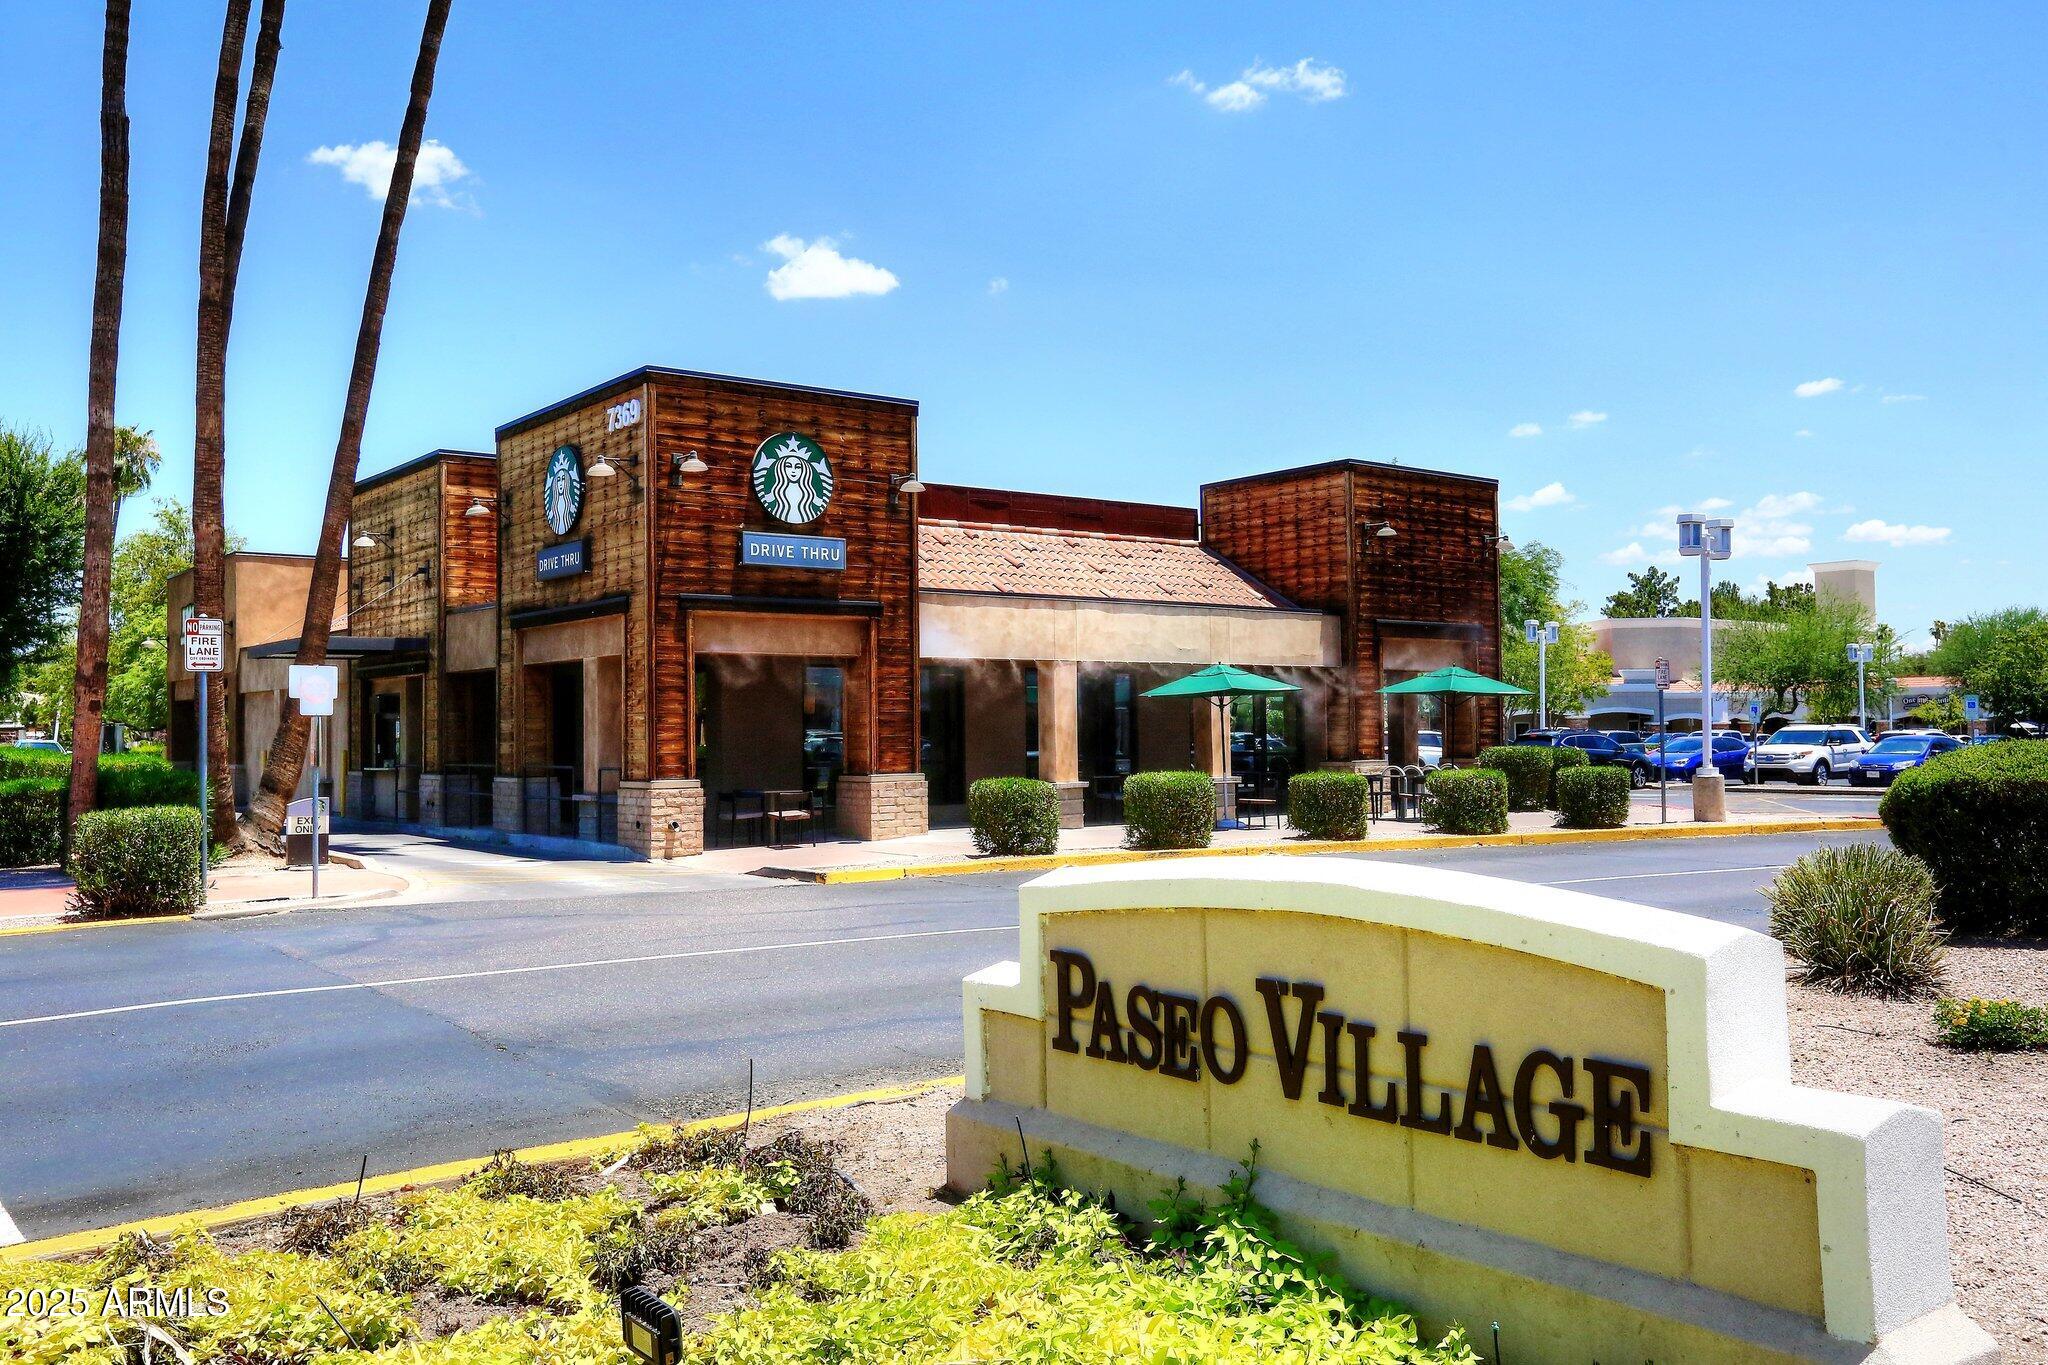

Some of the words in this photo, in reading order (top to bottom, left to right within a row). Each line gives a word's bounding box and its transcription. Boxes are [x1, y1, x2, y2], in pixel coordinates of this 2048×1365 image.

[607, 399, 641, 432] 7369
[749, 543, 795, 559] DRIVE
[801, 546, 840, 561] THRU
[539, 556, 559, 572] DRIVE
[560, 551, 580, 568] THRU
[187, 621, 198, 633] NO
[191, 637, 217, 645] FIRE
[189, 647, 219, 656] LANE
[297, 817, 320, 825] EXI
[1049, 949, 1248, 1085] PASEO
[1256, 977, 1652, 1178] VILLAGE
